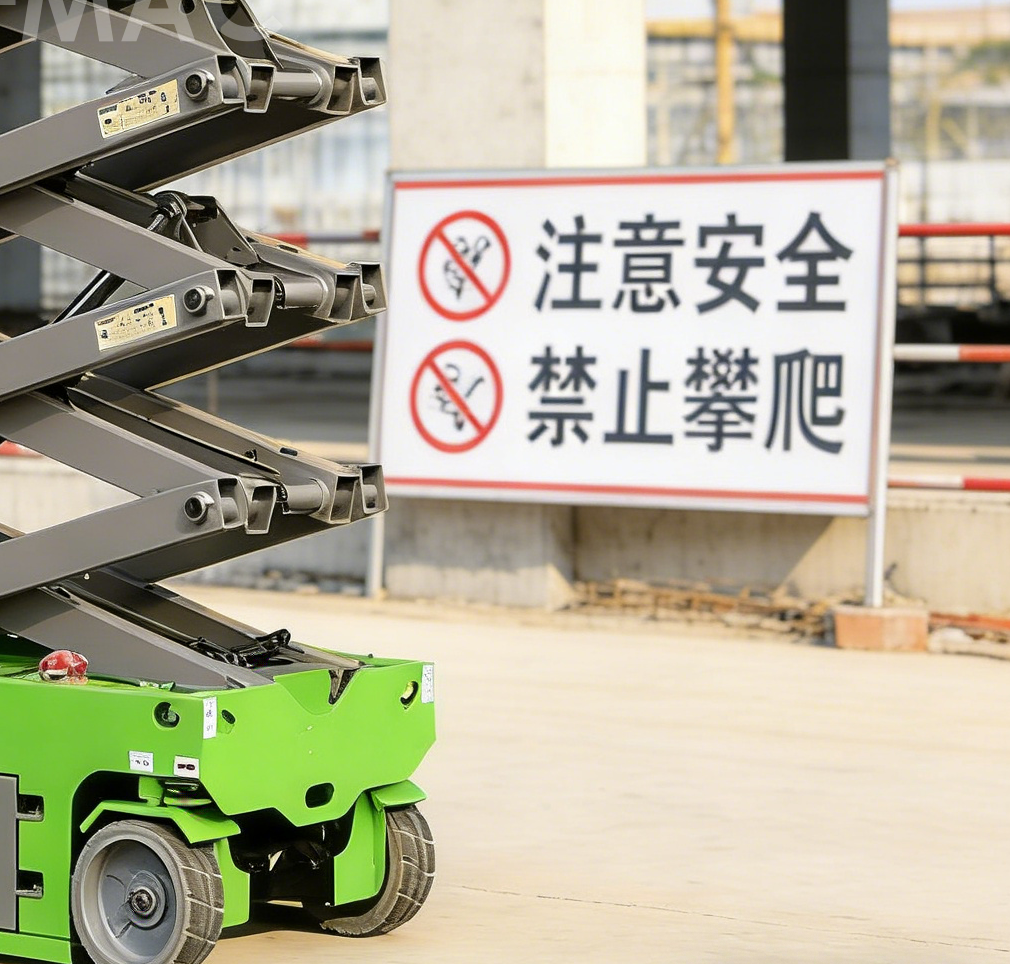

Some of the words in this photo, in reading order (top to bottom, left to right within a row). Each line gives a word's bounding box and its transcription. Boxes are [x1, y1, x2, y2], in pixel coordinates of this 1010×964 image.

[533, 211, 853, 315] 注意安全
[527, 346, 846, 454] 禁止攀爬
